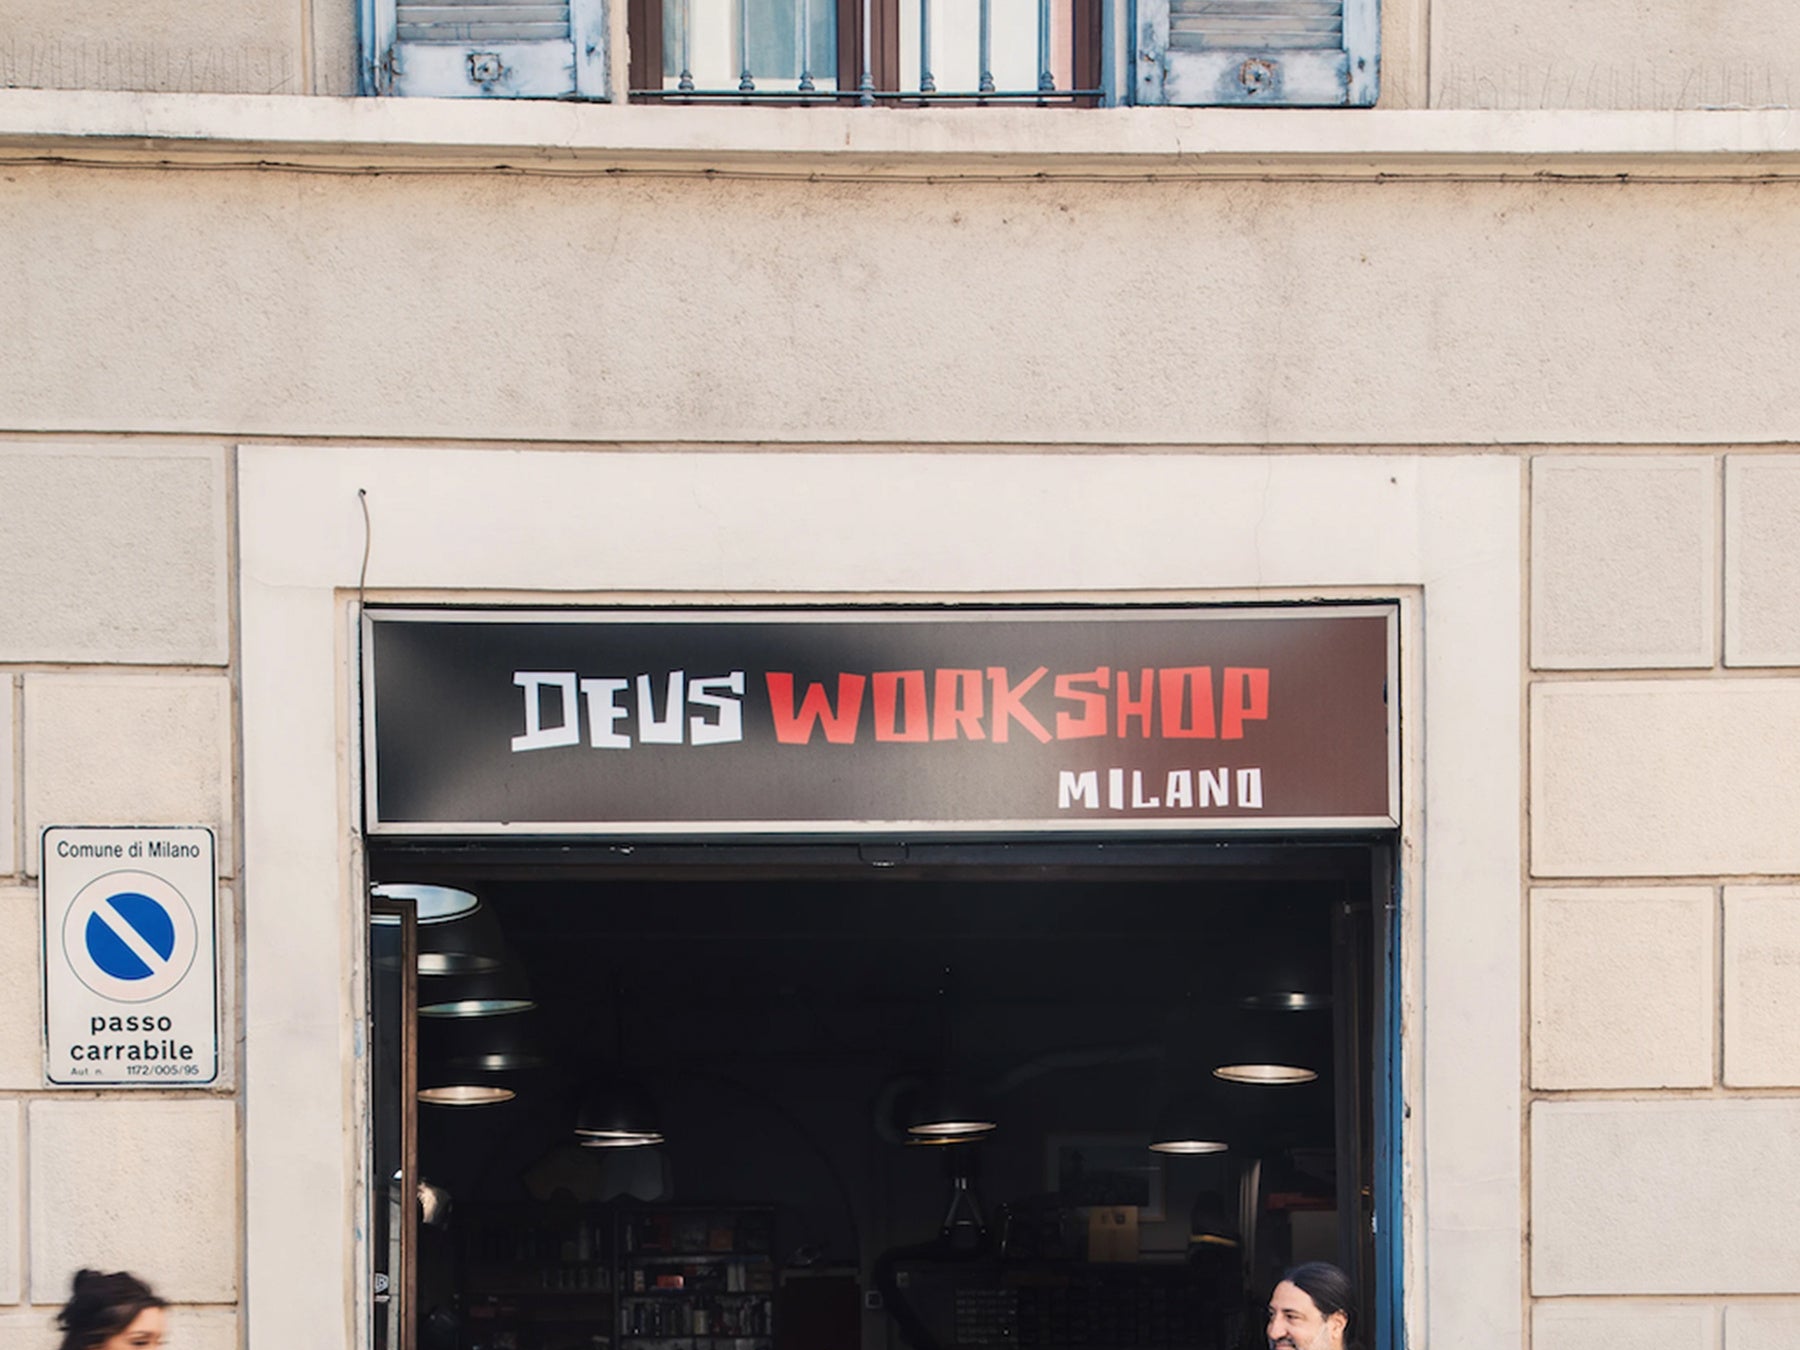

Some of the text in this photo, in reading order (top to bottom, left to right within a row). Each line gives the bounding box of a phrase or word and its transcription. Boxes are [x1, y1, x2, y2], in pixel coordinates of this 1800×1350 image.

[511, 665, 1270, 752] DEUS WORKSHOP
[1058, 767, 1264, 809] MILANO
[56, 840, 200, 858] Comune di Milano
[91, 1016, 172, 1036] passo
[70, 1040, 193, 1060] carrabile
